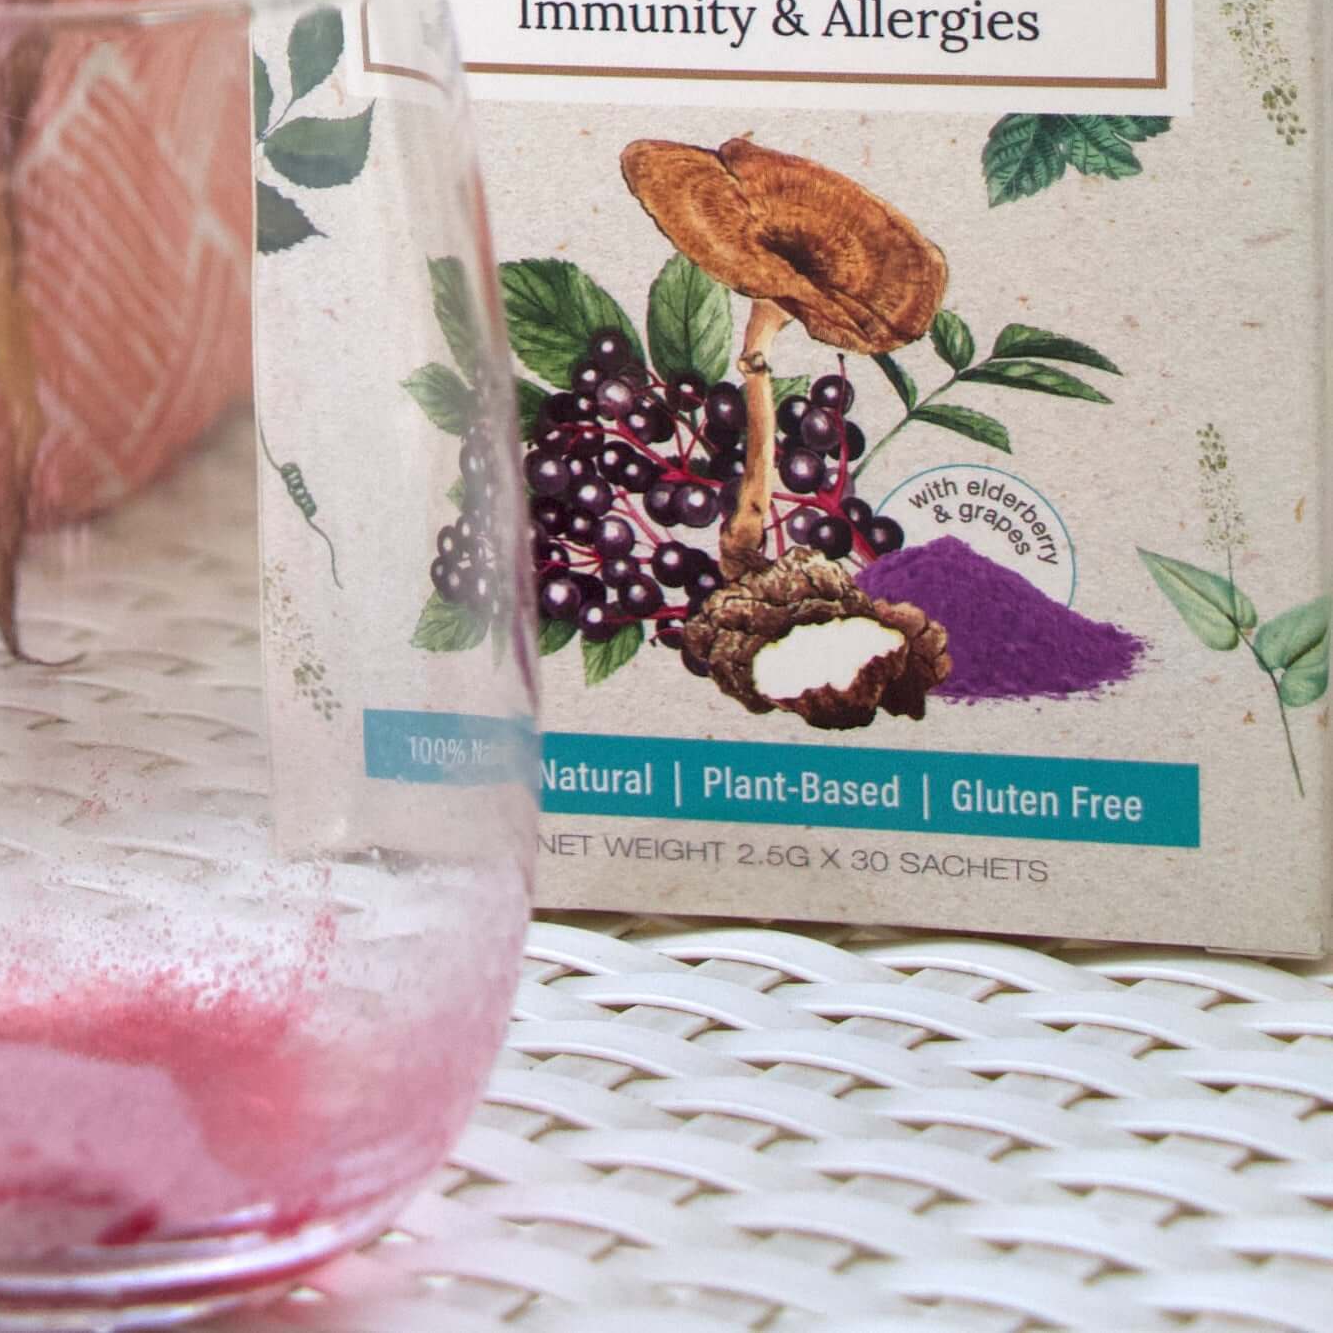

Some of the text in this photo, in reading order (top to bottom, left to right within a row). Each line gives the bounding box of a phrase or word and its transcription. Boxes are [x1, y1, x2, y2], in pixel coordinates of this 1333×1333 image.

[908, 477, 1059, 566] with elderberry
[932, 502, 1031, 556] & grapes
[539, 758, 1144, 822] Natural Plant-Based Gluten Free
[537, 833, 1049, 883] NET WEIGHT 2.5G X 30 SACHETS
